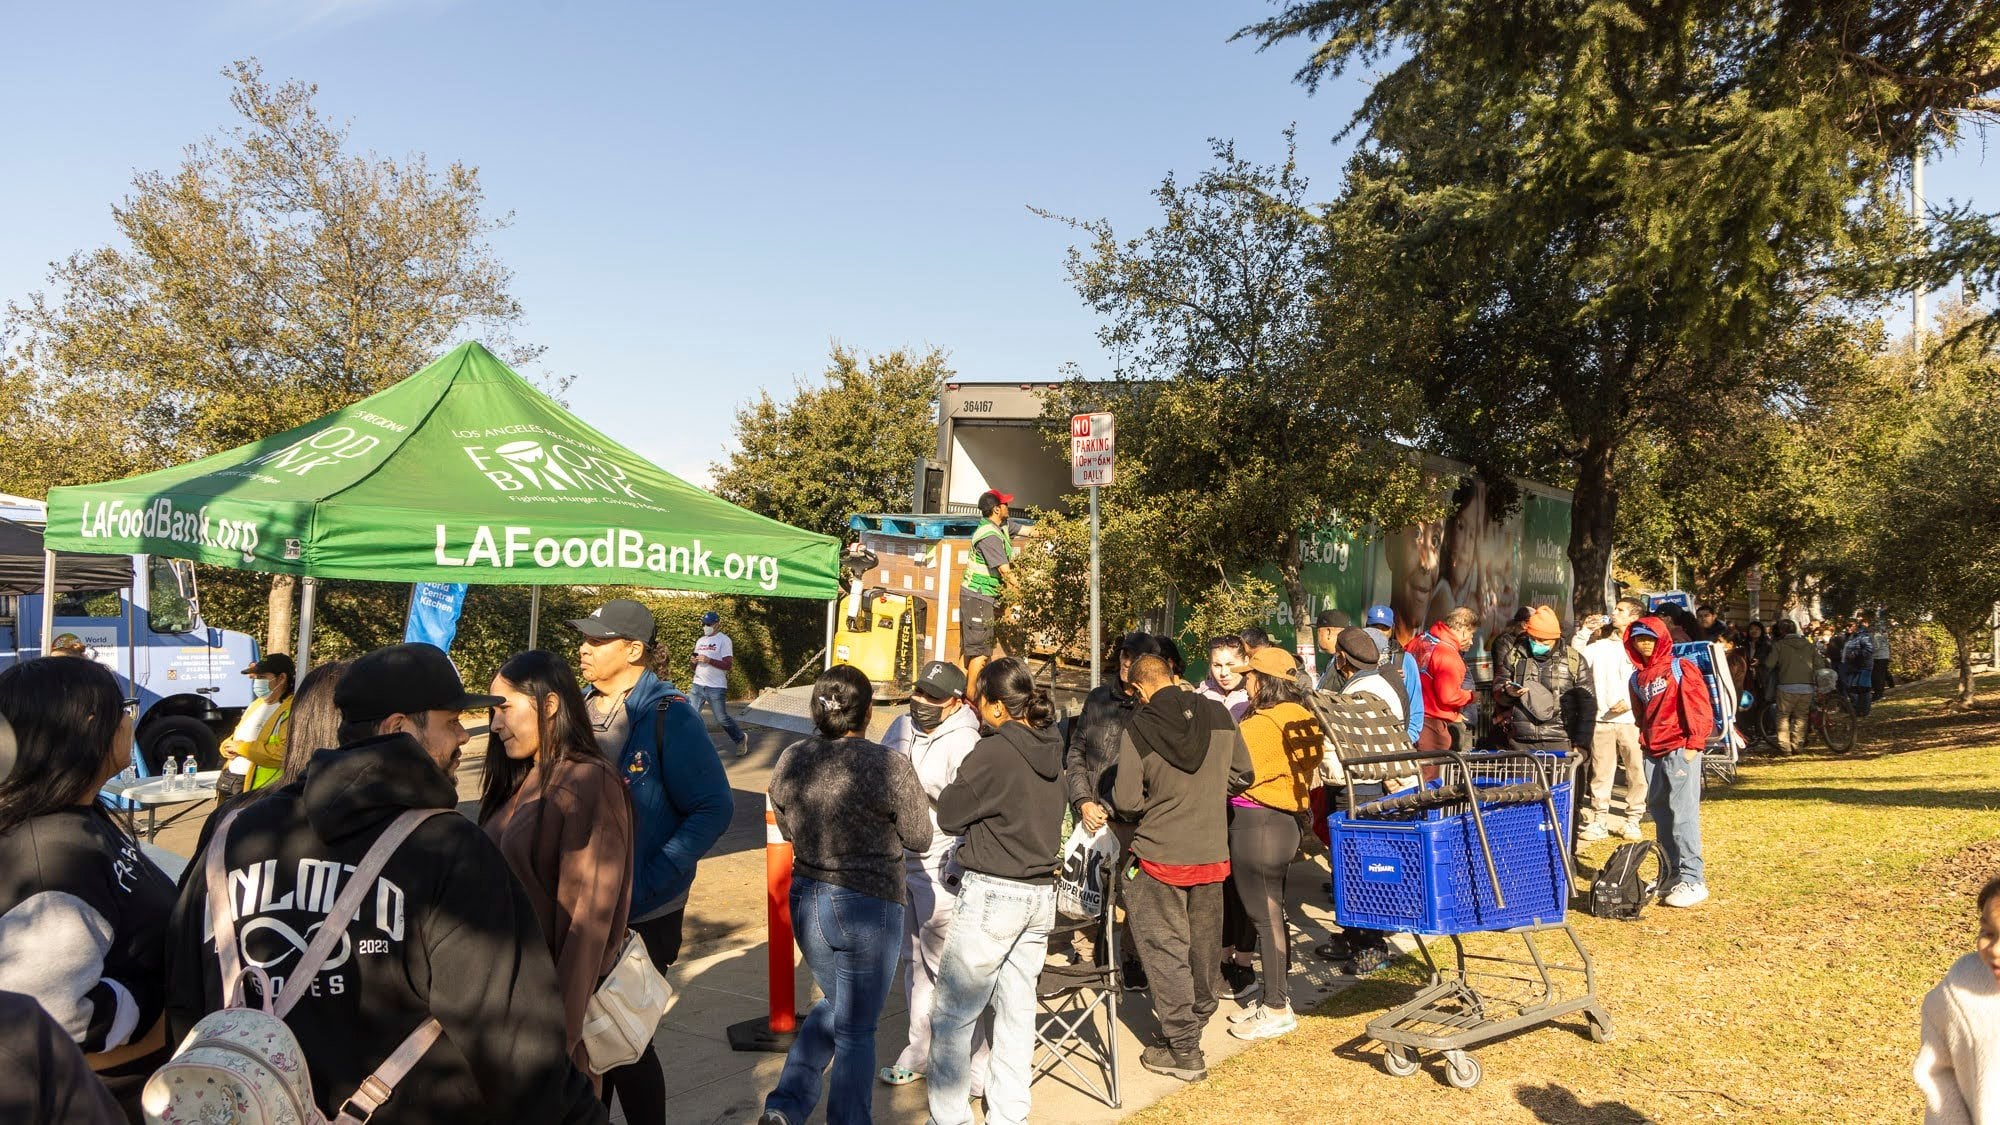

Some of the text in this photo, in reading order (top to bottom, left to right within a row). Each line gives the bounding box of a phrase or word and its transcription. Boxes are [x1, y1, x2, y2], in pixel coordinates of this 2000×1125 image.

[963, 400, 993, 412] 364167
[452, 430, 480, 438] LOS
[485, 424, 544, 437] ANGELES
[1074, 419, 1089, 436] NO
[1076, 438, 1109, 453] PARKING
[1075, 455, 1092, 467] 10PM
[1097, 454, 1111, 465] 6AM
[1083, 470, 1104, 480] DAILY
[81, 498, 258, 563] LAFoodBank.org
[434, 524, 779, 591] LAFoodBank.org
[422, 587, 454, 603] Central
[420, 595, 453, 612] Kitchen
[204, 858, 405, 945] NLMD
[1079, 889, 1100, 904] KING
[359, 939, 389, 954] 2023
[252, 975, 345, 998] SOES
